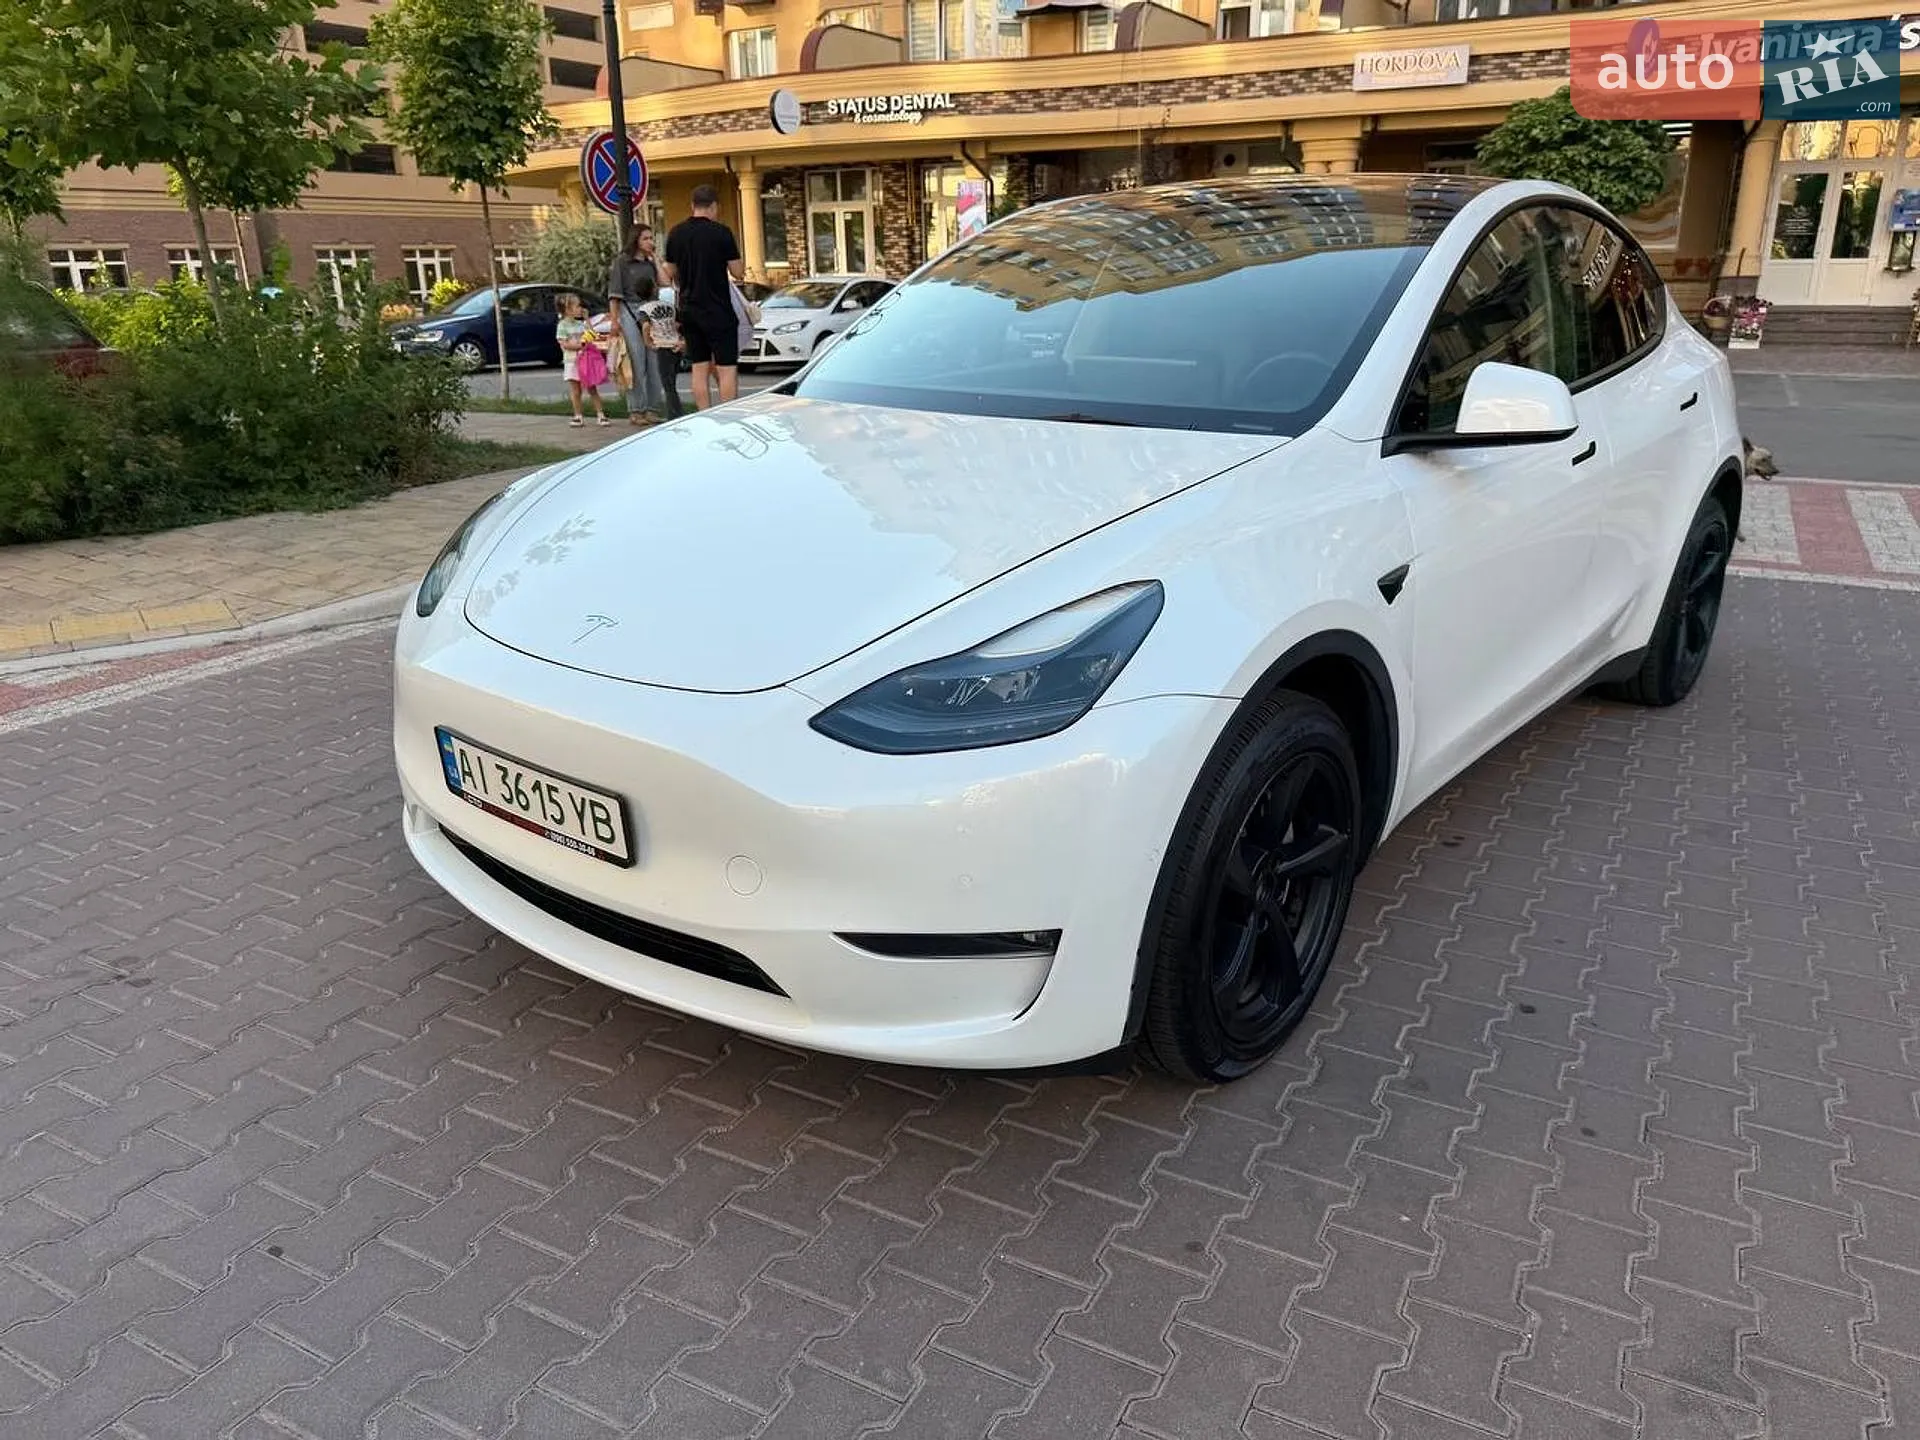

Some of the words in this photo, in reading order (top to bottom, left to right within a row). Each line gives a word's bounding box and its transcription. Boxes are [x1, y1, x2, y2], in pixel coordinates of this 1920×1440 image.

[1360, 51, 1461, 73] HORDOVA
[827, 96, 888, 115] STATUS
[890, 93, 956, 112] DENTAL
[862, 109, 922, 125] cosmetology
[459, 748, 488, 795] AI
[495, 763, 565, 826] 3615
[568, 791, 616, 844] YB
